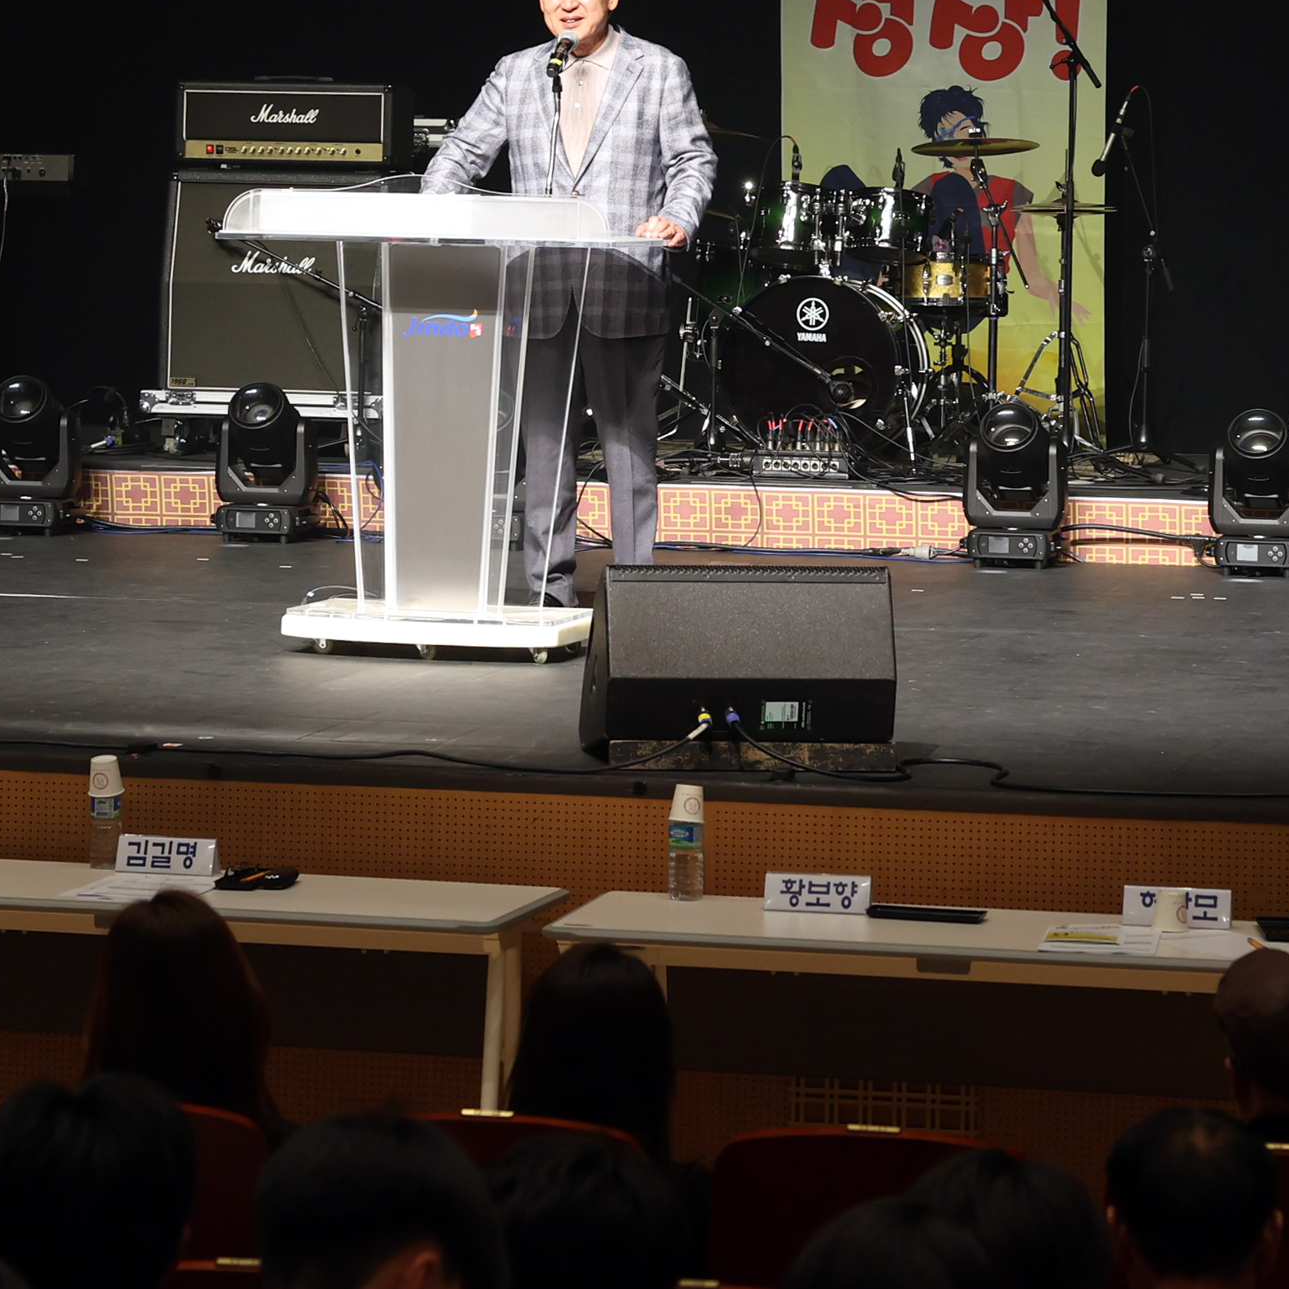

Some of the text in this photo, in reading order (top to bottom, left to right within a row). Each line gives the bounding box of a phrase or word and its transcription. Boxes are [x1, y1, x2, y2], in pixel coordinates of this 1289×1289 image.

[250, 103, 321, 125] Marshall
[403, 316, 470, 338] Jindo
[796, 331, 828, 343] YAMAHA
[126, 839, 198, 869] 김길명
[780, 878, 858, 909] 황보향
